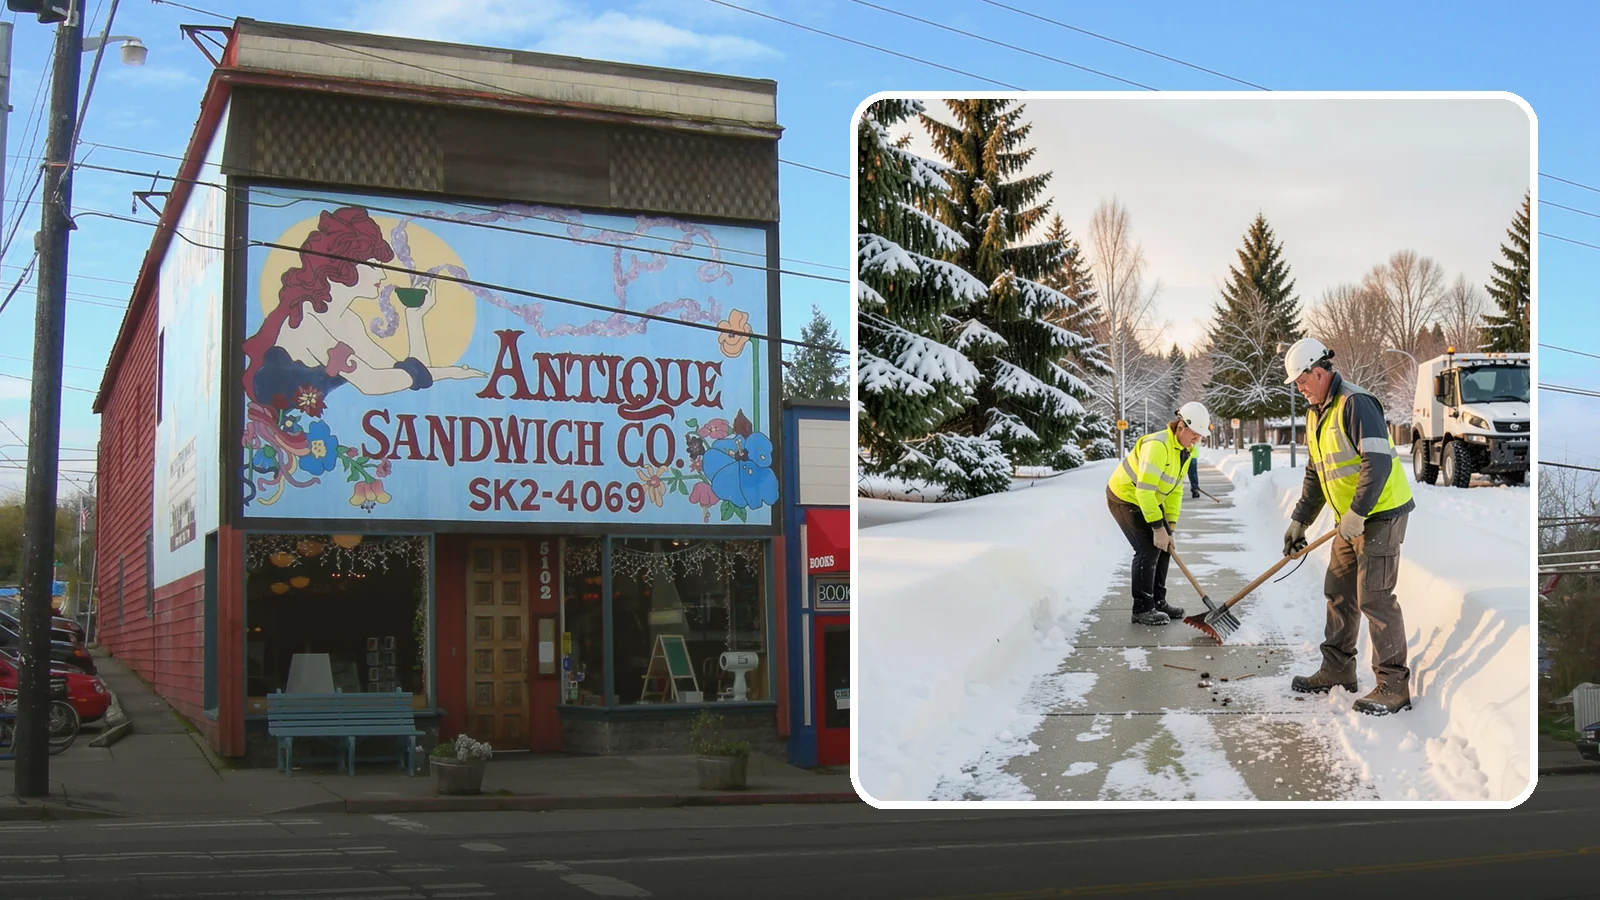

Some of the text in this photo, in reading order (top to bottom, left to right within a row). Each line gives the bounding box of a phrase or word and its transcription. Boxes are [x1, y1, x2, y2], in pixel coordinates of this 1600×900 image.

[475, 329, 724, 421] ANTIQUE
[361, 408, 685, 468] SANDWICH CO.
[468, 476, 646, 514] SK2-4069
[540, 541, 551, 599] 5102
[809, 555, 834, 568] BOOKS
